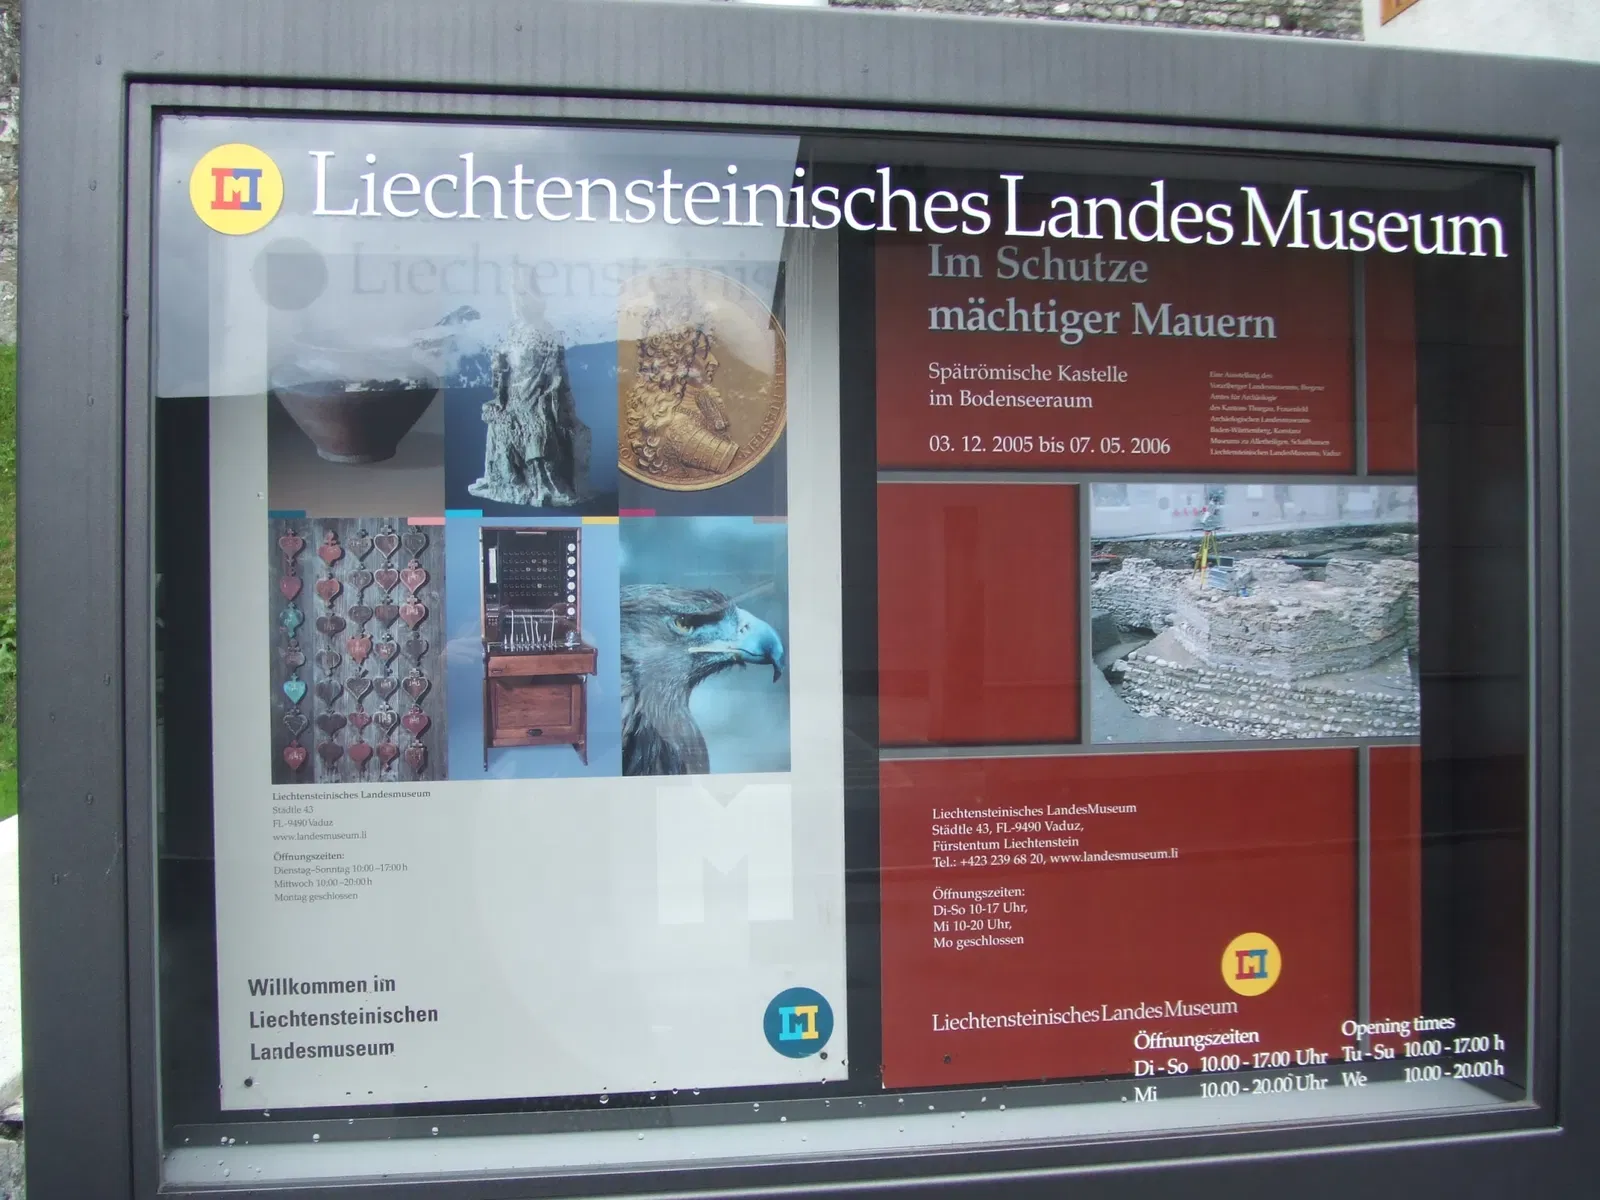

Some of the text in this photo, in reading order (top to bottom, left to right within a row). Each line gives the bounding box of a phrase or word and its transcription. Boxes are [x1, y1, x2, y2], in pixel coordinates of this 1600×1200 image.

[308, 150, 992, 236] Liechtensteinisches
[927, 243, 1149, 285] Im Schutze
[927, 297, 1278, 346] mächtiger Mauern
[928, 362, 1129, 385] Spätrömische Kastelle
[929, 389, 1094, 408] im Bodenseeraum
[928, 434, 1171, 455] 03. 12. 2005 bis 07. 05. 2006
[272, 789, 431, 801] Liechtensteinisches Landesmuseum
[303, 805, 314, 814] 43
[932, 803, 1138, 820] Liechtensteinisches LandesMuseum
[308, 818, 334, 827] Vaduz
[931, 820, 1085, 836] Städtle 43, FL-9490 Vaduz,
[272, 830, 367, 841] www.landesmuseum.li
[932, 836, 1080, 852] Fürstentum Liechtenstein
[273, 851, 345, 863] Öffnungszeiten:
[932, 847, 1179, 868] Tel.: +423 239 68 20, www.landesmuseum.li
[274, 878, 314, 889] Mittwoch
[274, 891, 359, 903] Montag geschlossen
[932, 886, 1026, 902] Öffnungszeiten:
[932, 901, 1029, 917] Di-So 10-17 Uhr,
[933, 918, 1013, 932] Mi 10-20 Uhr,
[933, 934, 1025, 951] Mo geschlossen
[247, 974, 396, 996] Willkommen im
[249, 1005, 439, 1029] Liechtensteinischen
[931, 1005, 1100, 1032] Liechtensteinisches
[1341, 1015, 1456, 1041] Opening times
[1134, 1028, 1261, 1052] Öffnungszeiten
[1341, 1045, 1363, 1063] Tu
[1374, 1043, 1396, 1061] Su
[1403, 1040, 1442, 1058] 10.00
[1453, 1036, 1490, 1055] 17.00
[1493, 1034, 1505, 1053] h
[250, 1041, 396, 1061] Landesmuseum
[1134, 1059, 1155, 1077] Di
[1167, 1057, 1189, 1075] So
[1199, 1054, 1240, 1073] 10.00
[1252, 1050, 1291, 1069] 17.00
[1295, 1048, 1329, 1066] Uhr
[1341, 1070, 1368, 1088] We
[1403, 1065, 1442, 1084] 10.00
[1453, 1061, 1492, 1080] 20.00
[1493, 1059, 1505, 1077] h
[1134, 1086, 1159, 1104] Mi
[1199, 1080, 1240, 1099] 10.00
[1252, 1076, 1293, 1095] 20.00
[1295, 1074, 1329, 1092] Uhr
